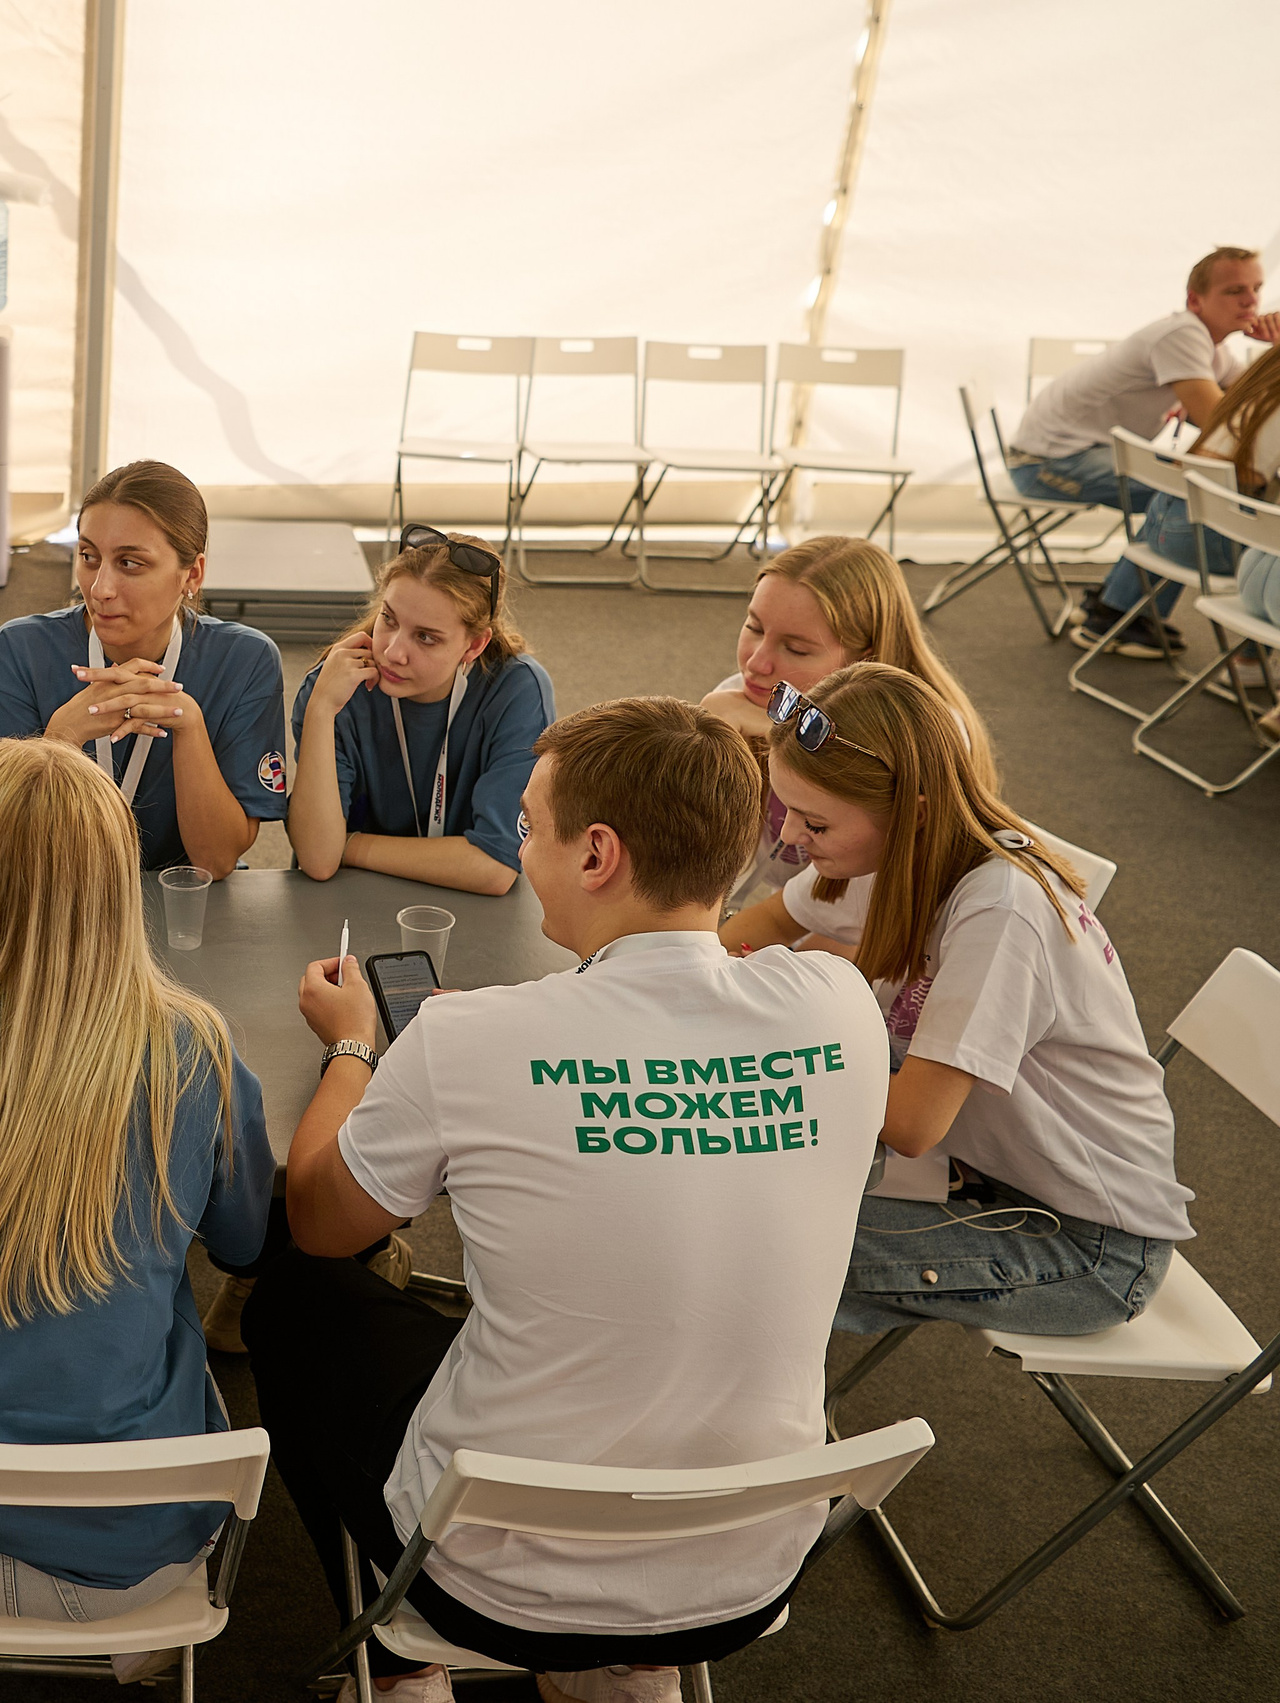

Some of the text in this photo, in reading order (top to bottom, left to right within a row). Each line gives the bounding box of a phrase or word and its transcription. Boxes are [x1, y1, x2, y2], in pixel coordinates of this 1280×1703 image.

[530, 1042, 845, 1086] МЫ ВМЕСТЕ
[580, 1085, 804, 1120] МОЖЕМ
[574, 1118, 819, 1155] БОЛЬШЕ!
